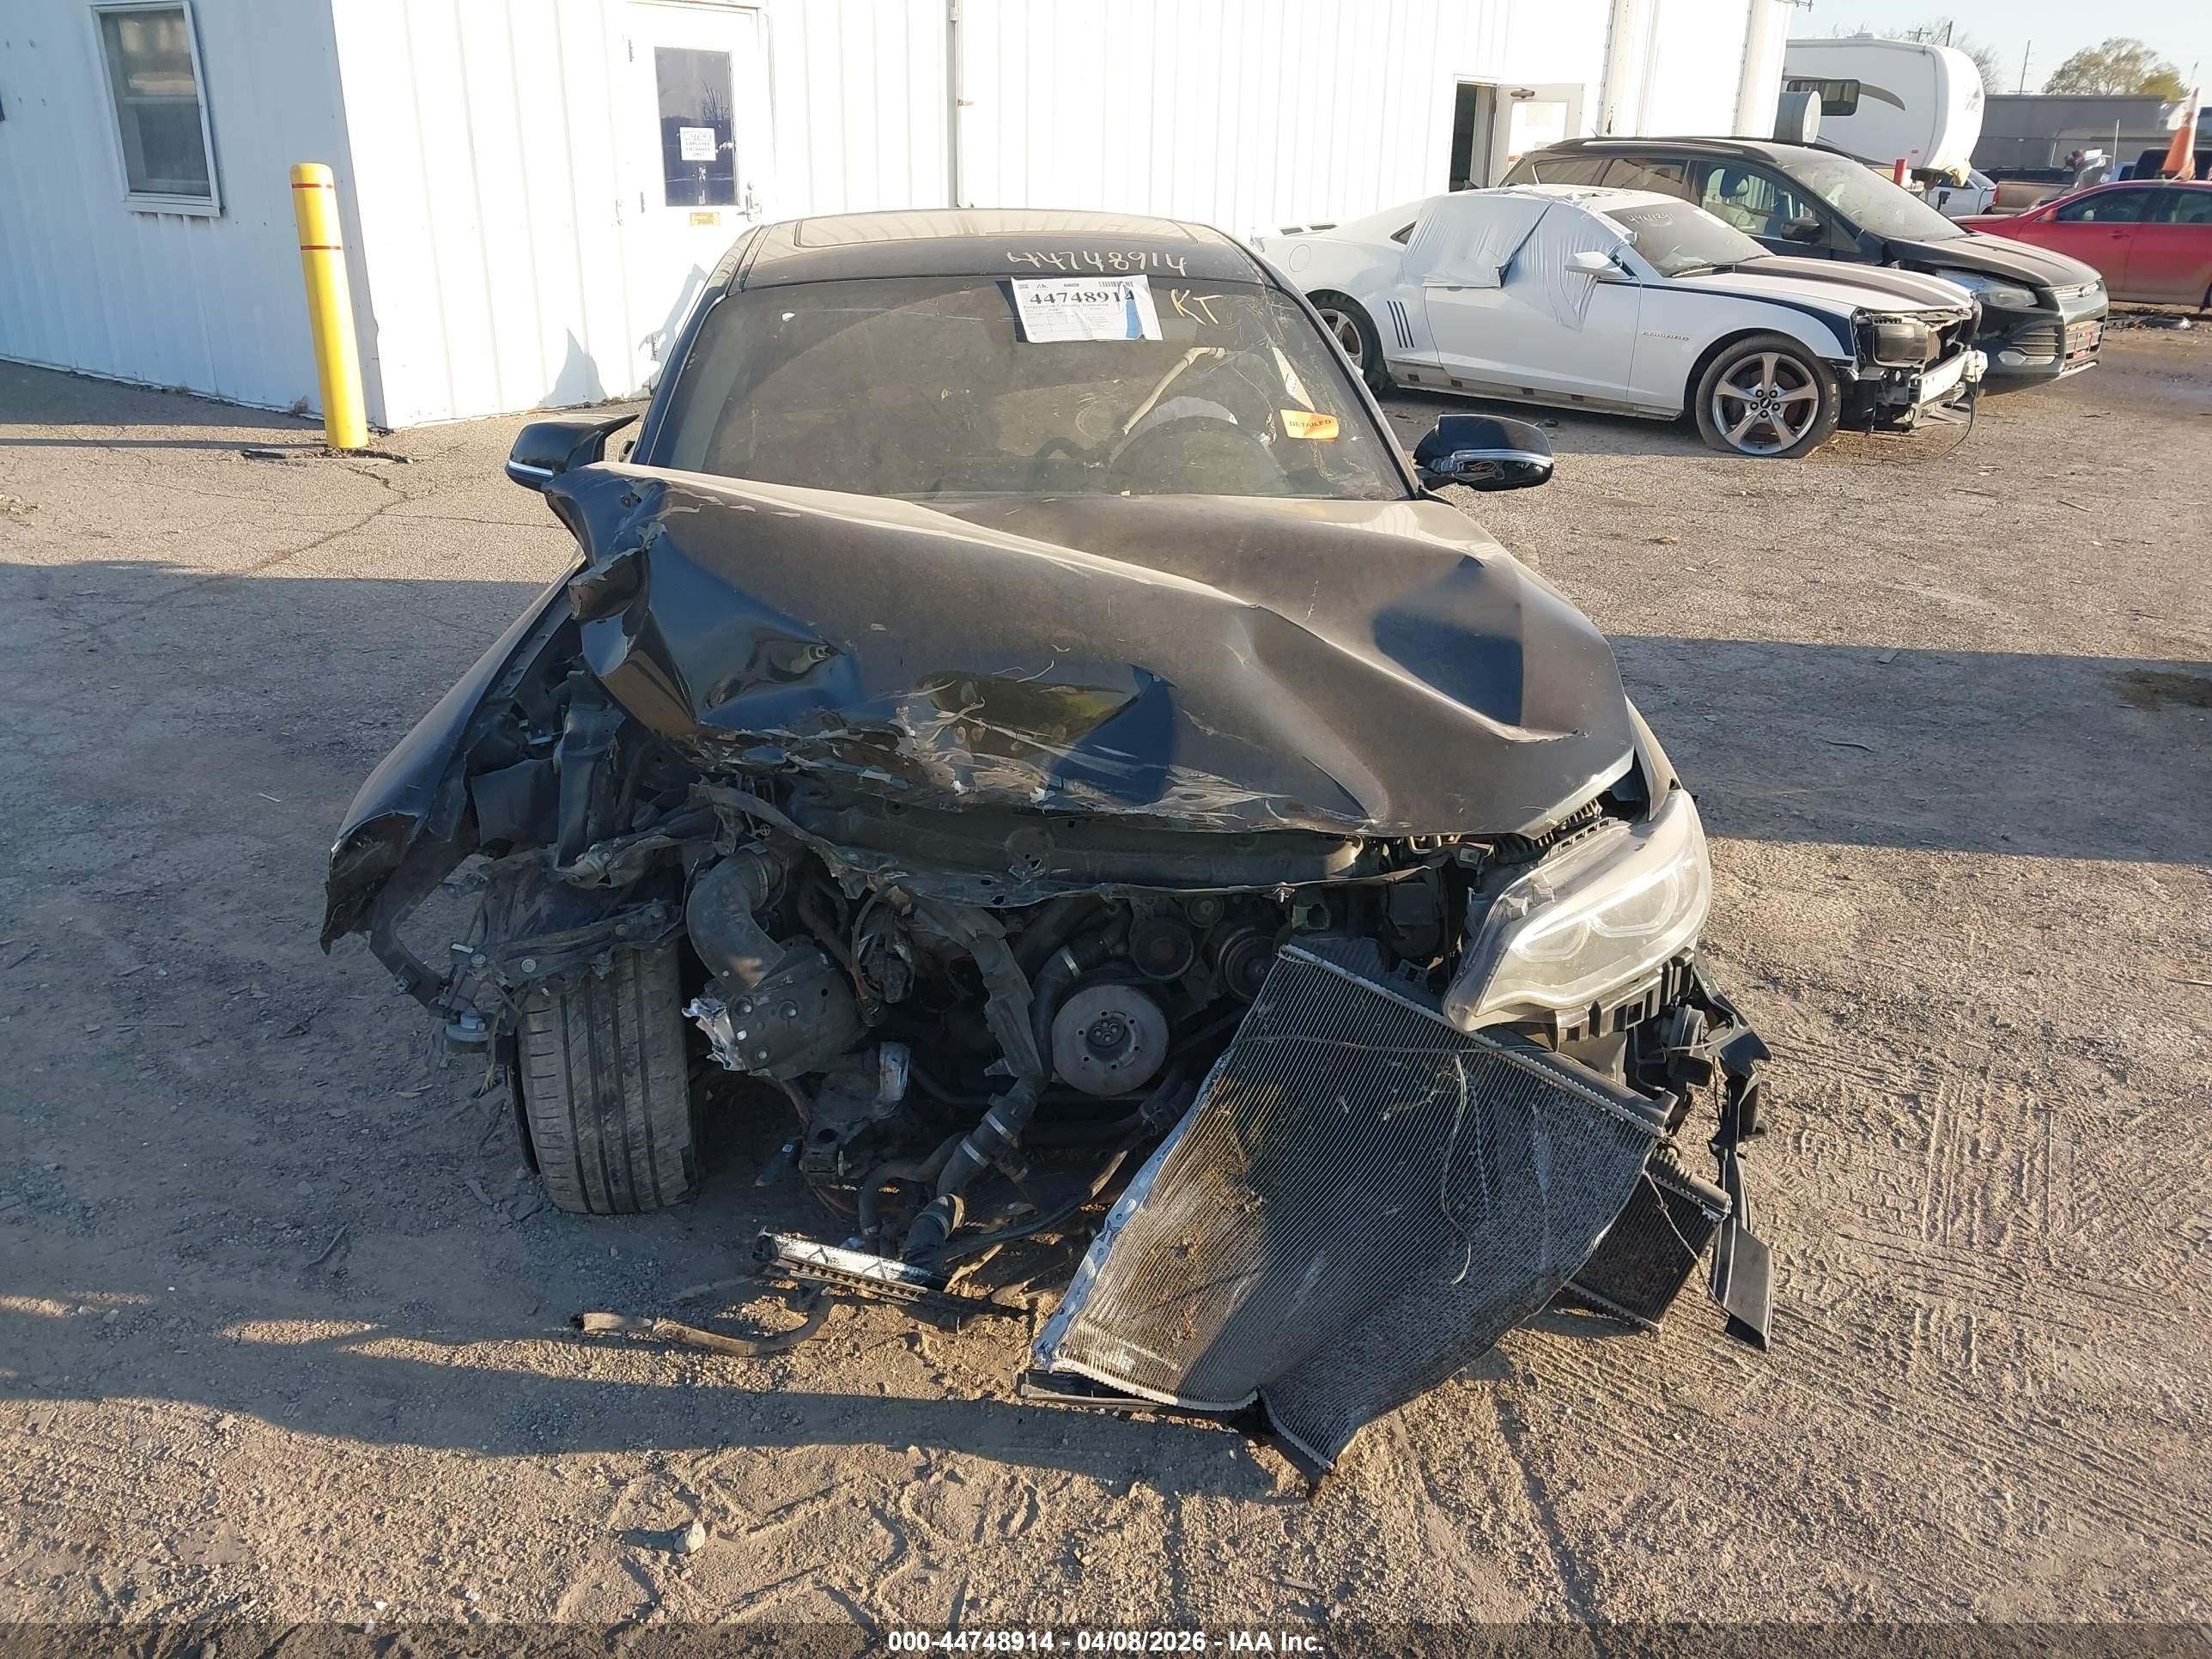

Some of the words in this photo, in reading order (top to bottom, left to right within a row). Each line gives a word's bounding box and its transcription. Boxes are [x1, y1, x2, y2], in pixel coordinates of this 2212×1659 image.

[1006, 250, 1188, 277] 44748914
[1030, 289, 1136, 305] 44748914
[1170, 289, 1224, 326] KT
[1289, 419, 1332, 428] DETAILED
